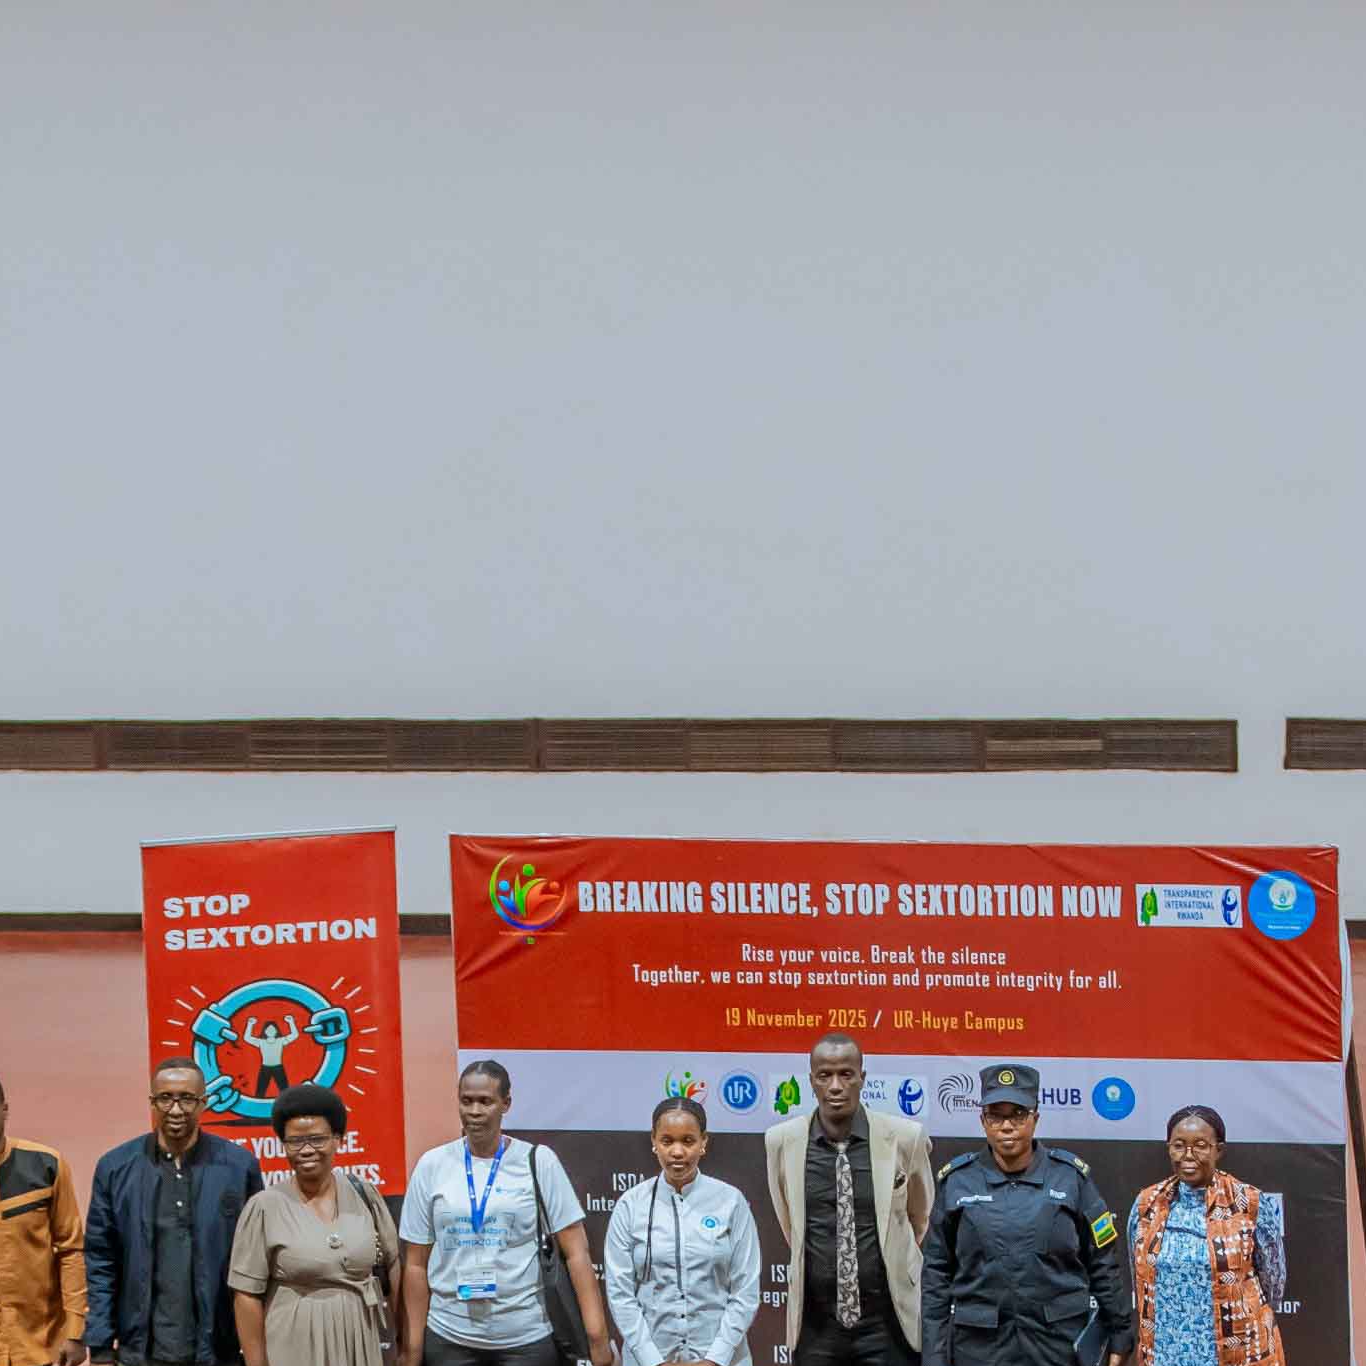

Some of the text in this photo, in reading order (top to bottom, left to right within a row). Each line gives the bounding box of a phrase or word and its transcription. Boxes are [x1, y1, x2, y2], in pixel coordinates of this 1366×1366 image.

[578, 881, 1122, 918] BREAKING SILENCE, STOP SEXTORTION NOW
[1163, 889, 1213, 899] TRANSPARENCY
[1164, 900, 1215, 910] INTERNATIONAL
[163, 893, 250, 920] STOP
[1177, 911, 1204, 921] RWANDA
[164, 917, 377, 952] SEXTORTION
[742, 943, 774, 964] Rise
[780, 947, 815, 966] your
[871, 945, 915, 965] Break
[921, 945, 945, 965] the
[951, 946, 1006, 966] silence
[710, 969, 731, 984] we
[737, 970, 763, 985] can
[768, 966, 801, 988] stop
[808, 966, 886, 987] sextortion
[893, 968, 920, 987] and
[925, 971, 990, 991] promote
[996, 971, 1062, 992] integrity
[1069, 970, 1092, 989] for
[1098, 971, 1122, 990] all.
[725, 1007, 741, 1026] 19
[746, 1007, 822, 1028] November
[828, 1008, 867, 1028] 2025
[893, 1010, 958, 1032] UR-Huye
[965, 1011, 1025, 1032] Campus
[1039, 1088, 1081, 1106] HUB
